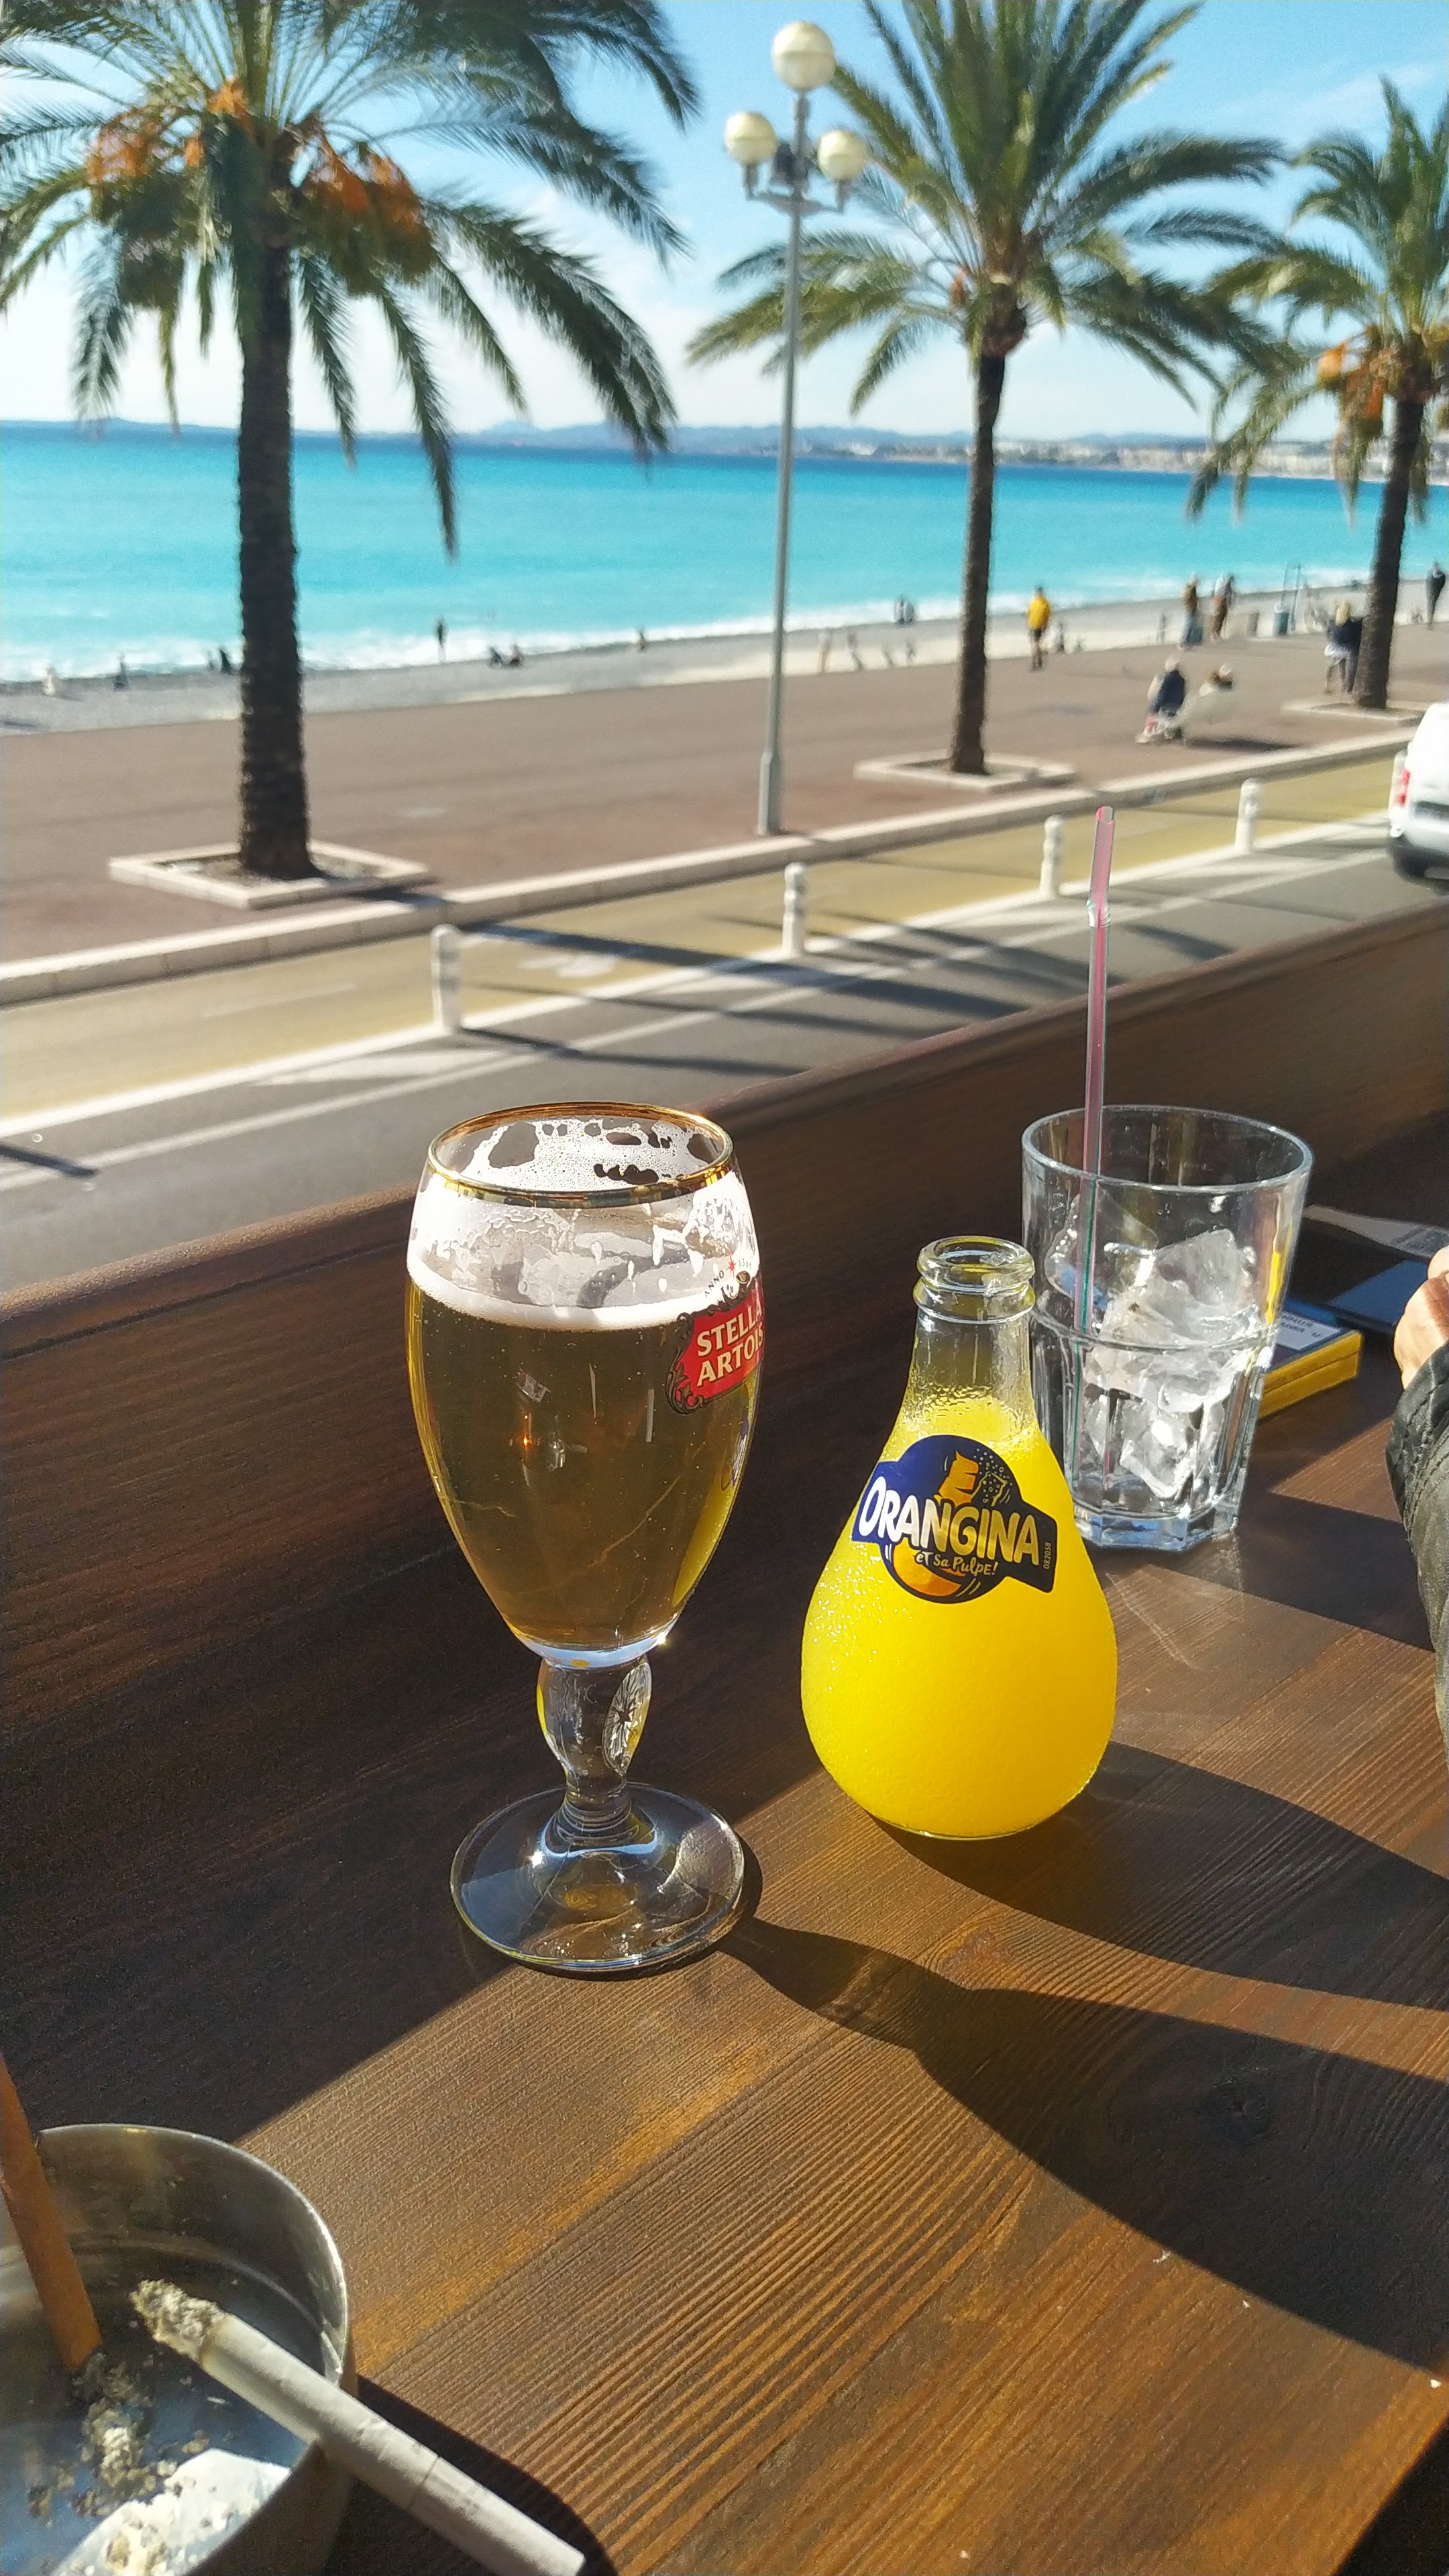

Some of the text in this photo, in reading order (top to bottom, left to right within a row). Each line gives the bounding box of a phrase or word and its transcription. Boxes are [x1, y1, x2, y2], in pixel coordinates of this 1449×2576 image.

[704, 1270, 724, 1297] ANNO
[697, 1300, 762, 1356] STELLA
[697, 1322, 763, 1387] ARTOIS
[858, 1476, 1039, 1566] ORANGINA
